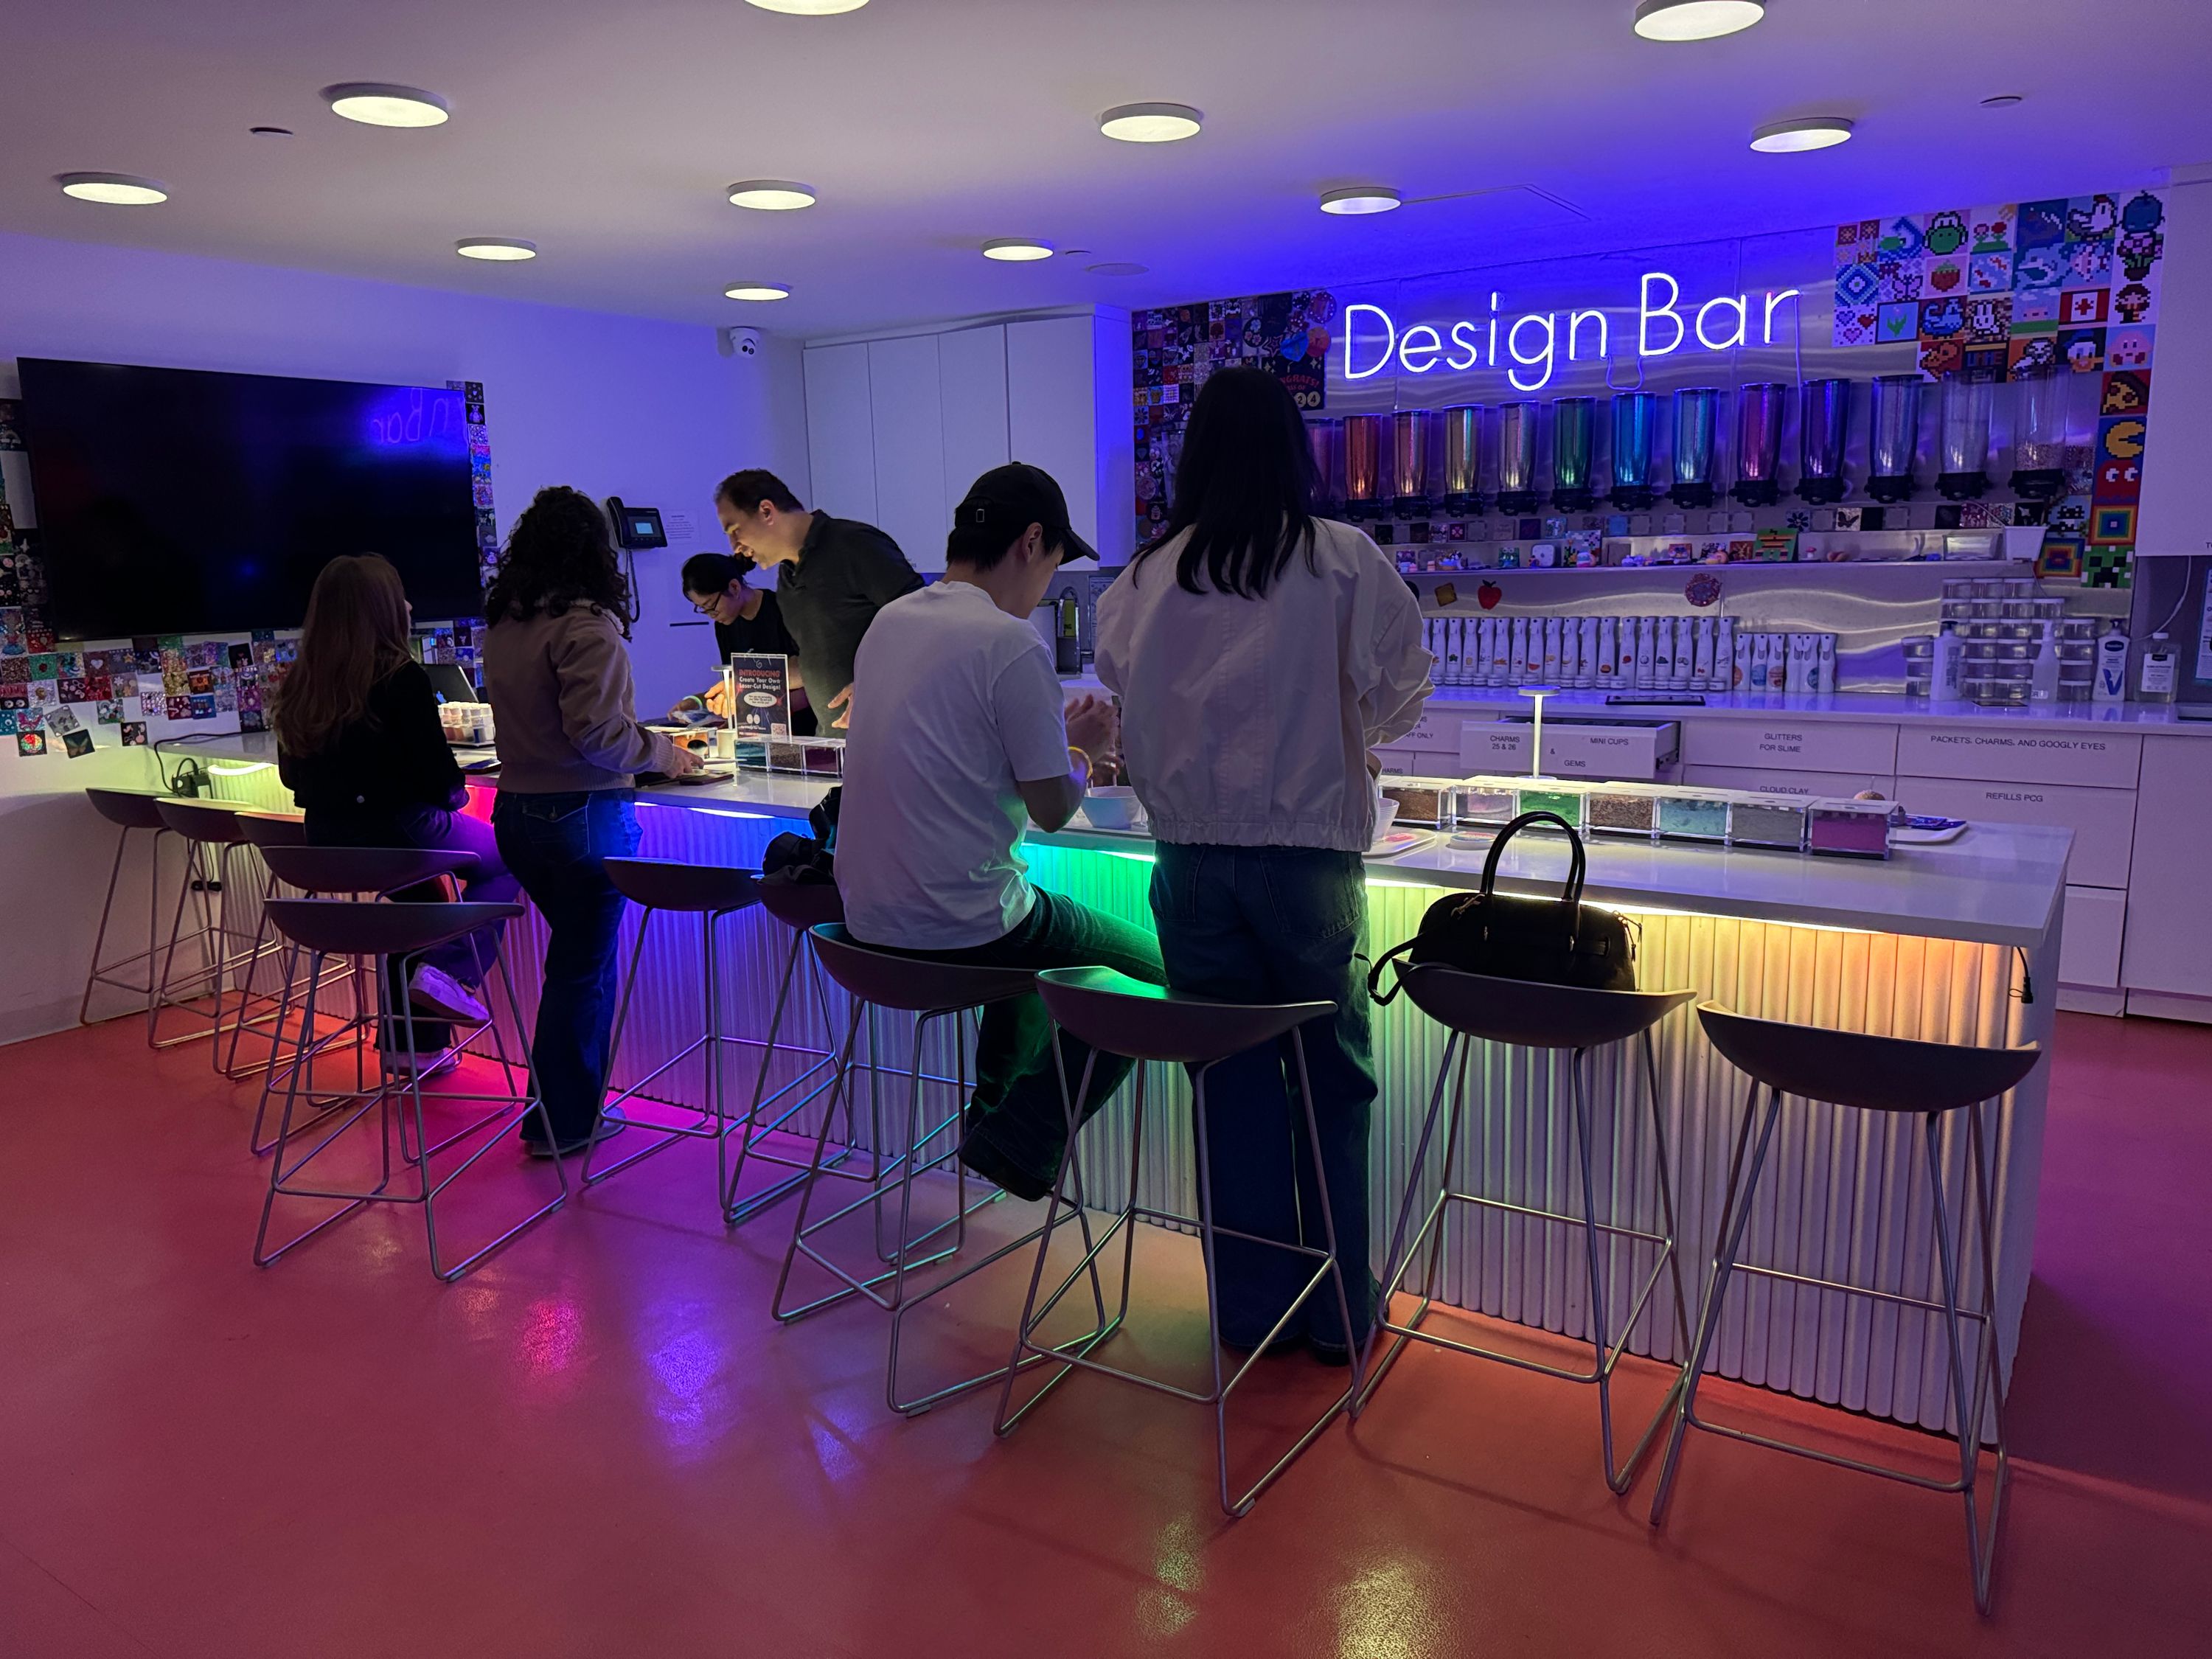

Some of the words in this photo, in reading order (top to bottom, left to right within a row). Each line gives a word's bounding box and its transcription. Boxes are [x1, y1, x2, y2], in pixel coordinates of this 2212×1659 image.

[1343, 291, 1609, 392] Design
[1638, 271, 1801, 357] Bar
[1279, 374, 1320, 388] NGRATS!
[739, 669, 780, 678] INTRODUCING
[762, 683, 781, 692] Design!
[1489, 734, 1520, 743] CHARMS
[1607, 738, 1629, 746] CUPS
[1764, 733, 1803, 742] GLITTERS
[1759, 743, 1776, 751] FOR
[1777, 745, 1801, 753] SLIME
[2017, 739, 2037, 748] AND
[2039, 740, 2079, 749] GOOGLY
[2081, 742, 2106, 751] EYES
[1563, 759, 1586, 768] GEMS
[1759, 785, 1787, 794] CLOUD
[1788, 787, 1809, 796] CLAY
[1985, 792, 2022, 801] REFILLS
[2023, 793, 2043, 802] PCG
